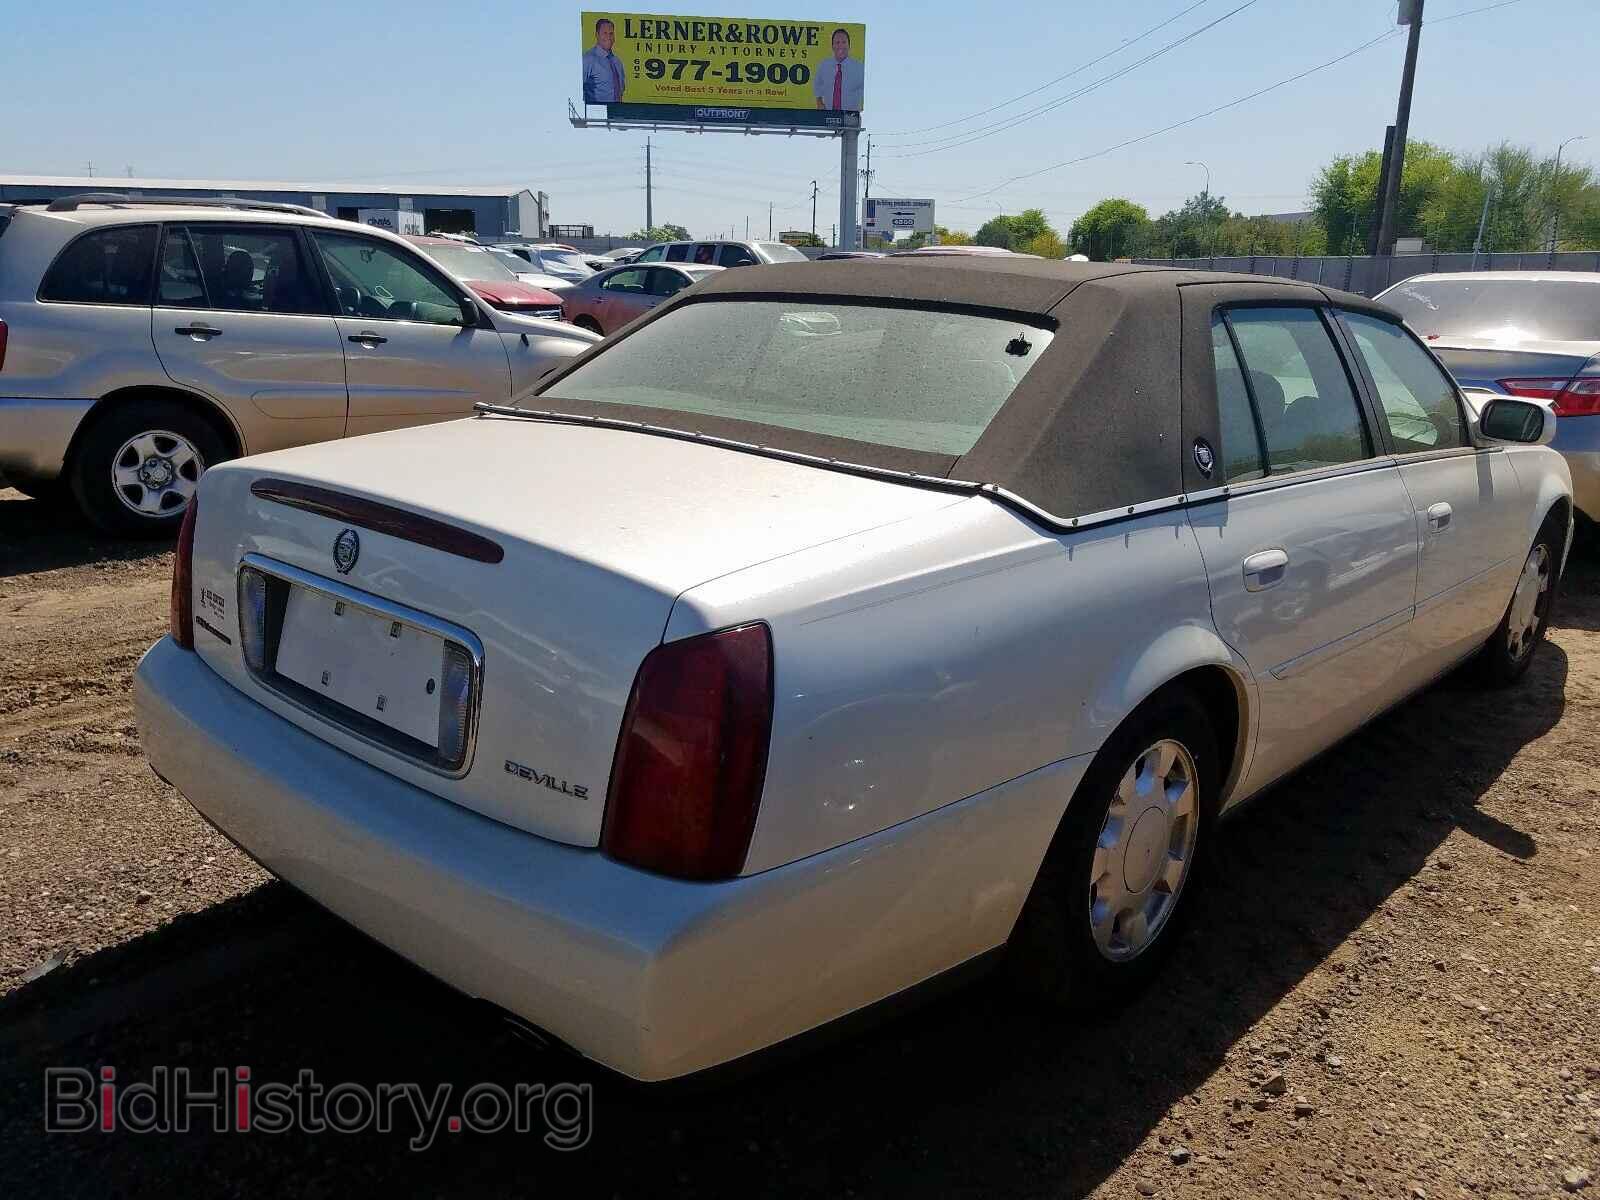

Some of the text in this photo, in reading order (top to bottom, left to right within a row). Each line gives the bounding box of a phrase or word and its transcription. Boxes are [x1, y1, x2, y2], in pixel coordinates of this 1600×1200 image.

[636, 43, 808, 59] INJURY ATTORNEYS
[644, 58, 811, 85] 977-1900
[655, 84, 682, 92] Voted
[685, 85, 706, 93] Best
[708, 86, 714, 94] 5
[718, 87, 743, 95] Years
[765, 88, 787, 96] Row!
[696, 107, 748, 120] OUTFRONT
[504, 760, 589, 801] DEVILLE
